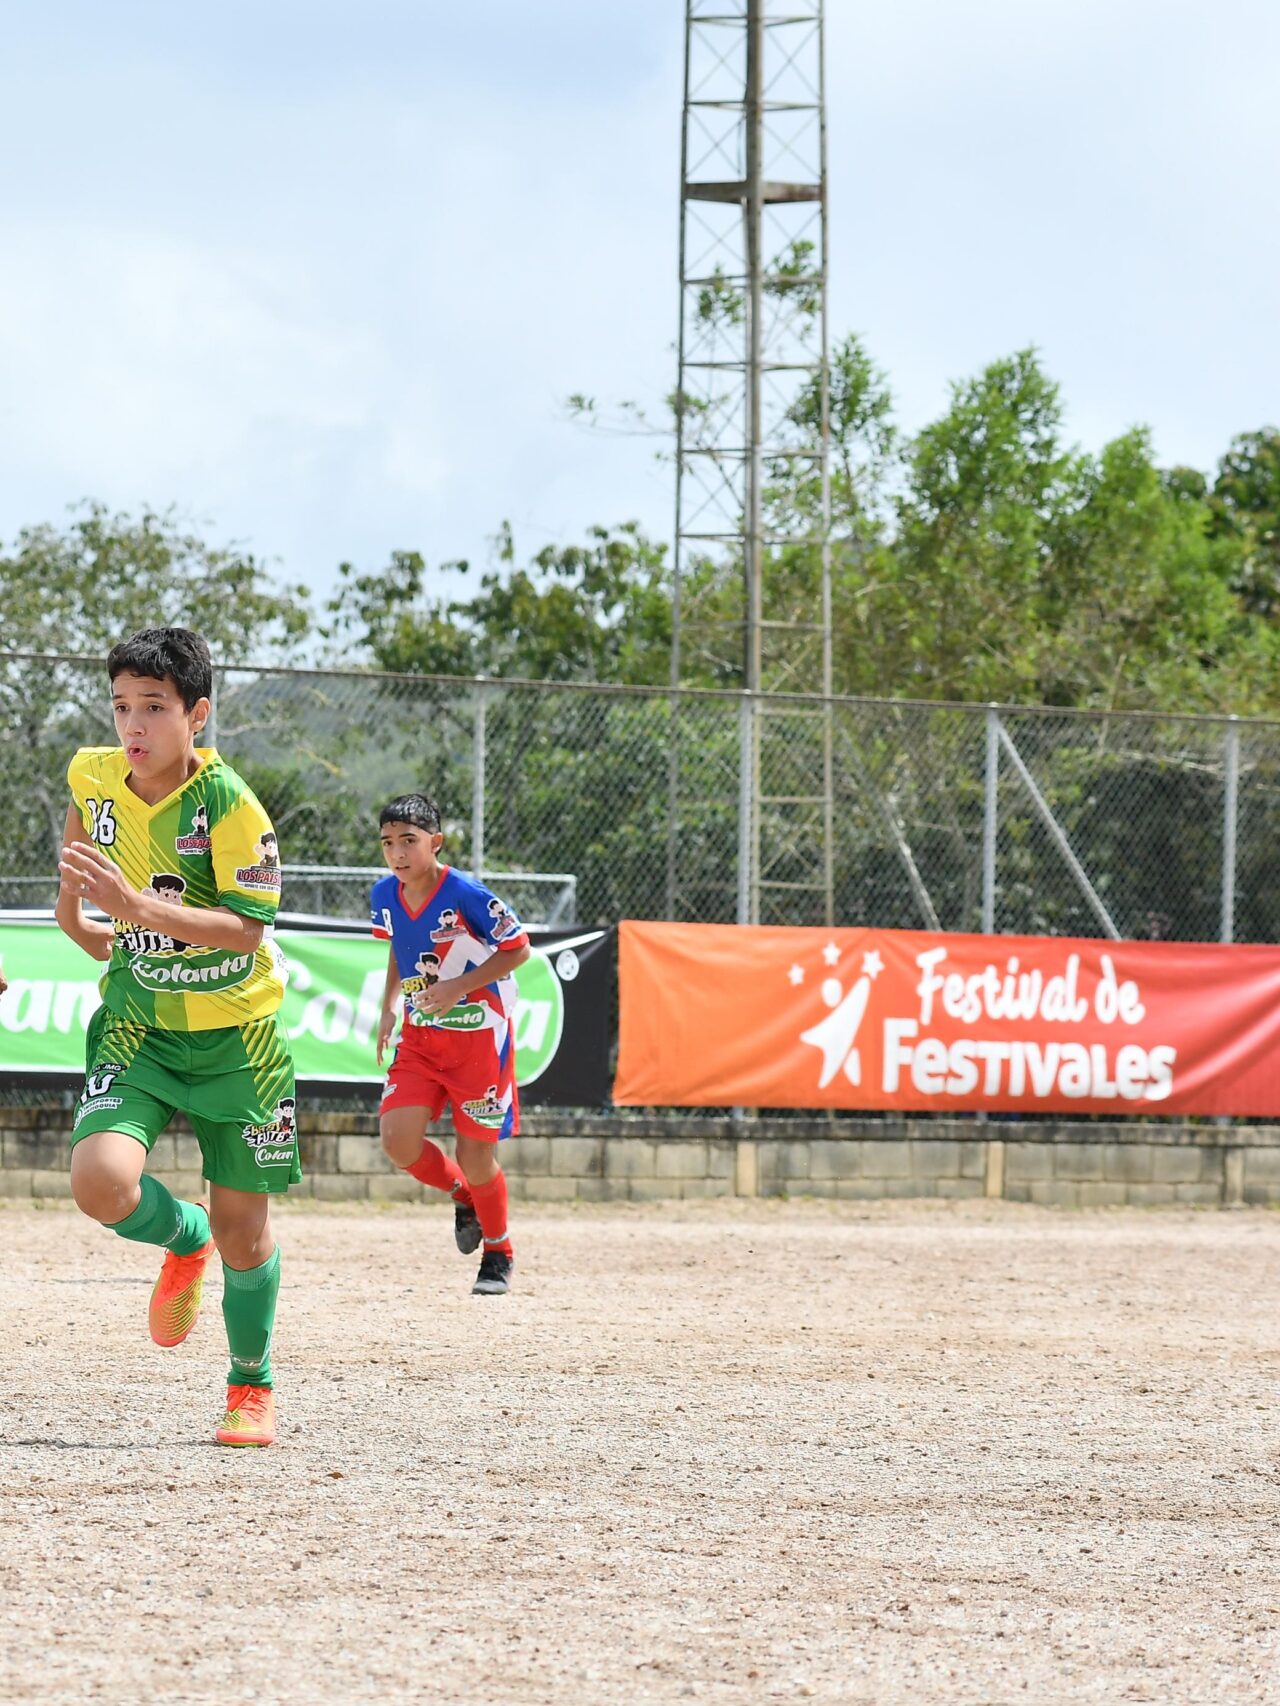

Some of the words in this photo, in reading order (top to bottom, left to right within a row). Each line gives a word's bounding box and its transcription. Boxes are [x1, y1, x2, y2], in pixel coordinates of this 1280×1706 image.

[237, 869, 256, 882] LOS
[257, 870, 280, 885] PAIS
[131, 954, 250, 984] Colanta
[915, 946, 1089, 1026] Festival
[1094, 953, 1146, 1025] de
[257, 1148, 294, 1162] Colan
